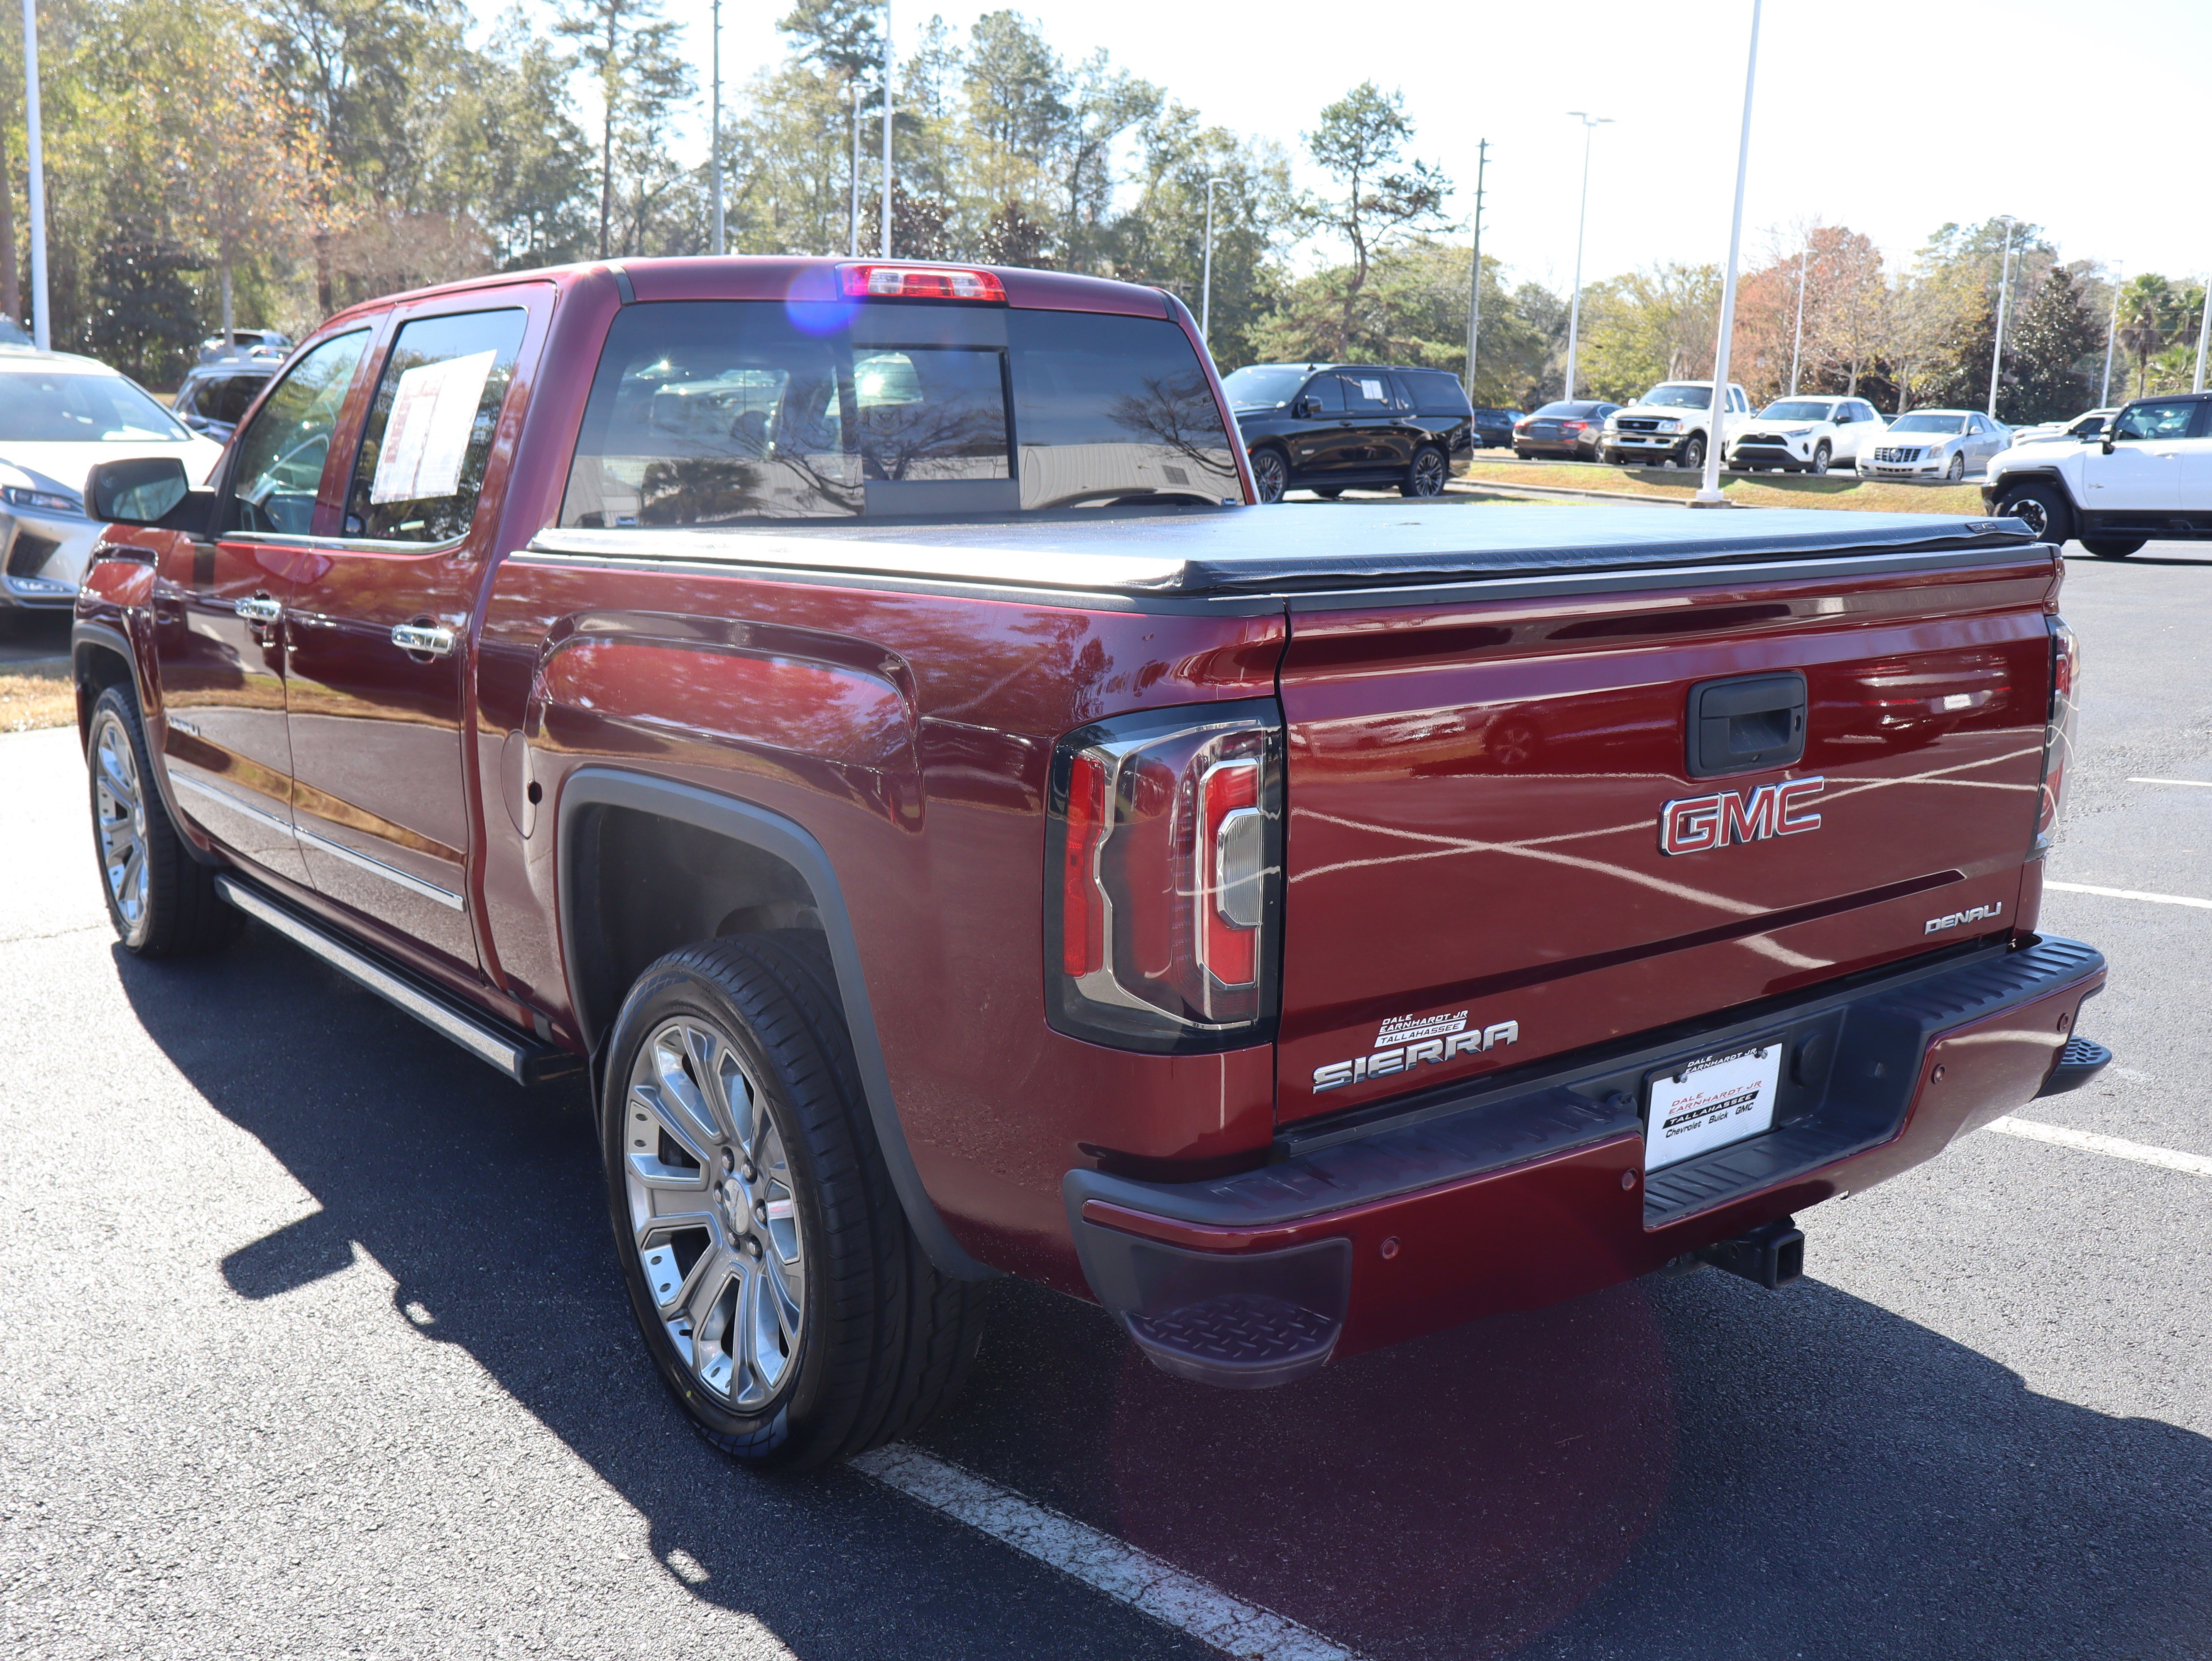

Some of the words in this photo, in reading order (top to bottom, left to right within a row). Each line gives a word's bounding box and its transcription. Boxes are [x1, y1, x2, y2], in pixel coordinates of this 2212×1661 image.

[1659, 775, 1825, 856] GMC
[1924, 901, 2002, 935] DENALI
[1379, 1013, 1451, 1033] EARNHARDT
[1453, 1010, 1468, 1019] JR
[1381, 1022, 1461, 1044] TALLAHASSEE
[1382, 1014, 1413, 1026] DALE
[1312, 1019, 1519, 1095] SIERRA
[1685, 1052, 1743, 1074] EARNHARDT
[1744, 1048, 1757, 1056] JR
[1687, 1055, 1713, 1068] DALE
[1668, 1086, 1744, 1115] EARNHARDT
[1746, 1080, 1762, 1090] JR
[1670, 1093, 1753, 1125] TALLAHASSEE
[1671, 1092, 1704, 1107] DALE
[1666, 1120, 1702, 1138] Chevrolet
[1708, 1111, 1729, 1124] Buick
[1735, 1102, 1754, 1115] GMC
